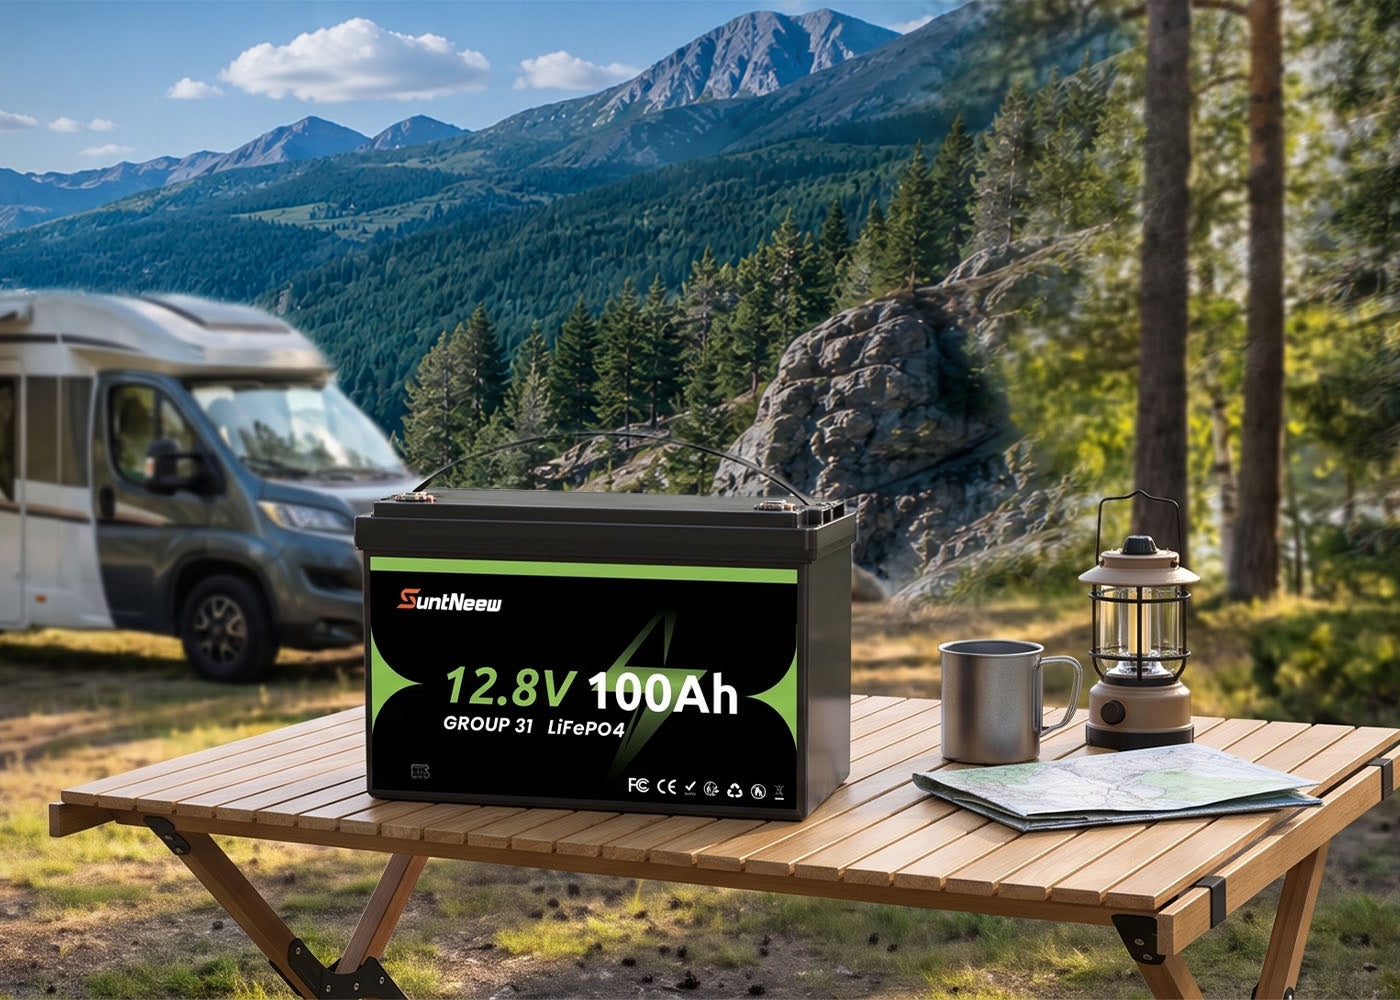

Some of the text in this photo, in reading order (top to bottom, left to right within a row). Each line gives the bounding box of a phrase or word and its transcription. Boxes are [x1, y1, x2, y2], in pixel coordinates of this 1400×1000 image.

[397, 588, 502, 612] SuntNeew
[447, 666, 738, 715] 12.8V 100Ah
[443, 715, 625, 738] GROUP 31 LiFePO4
